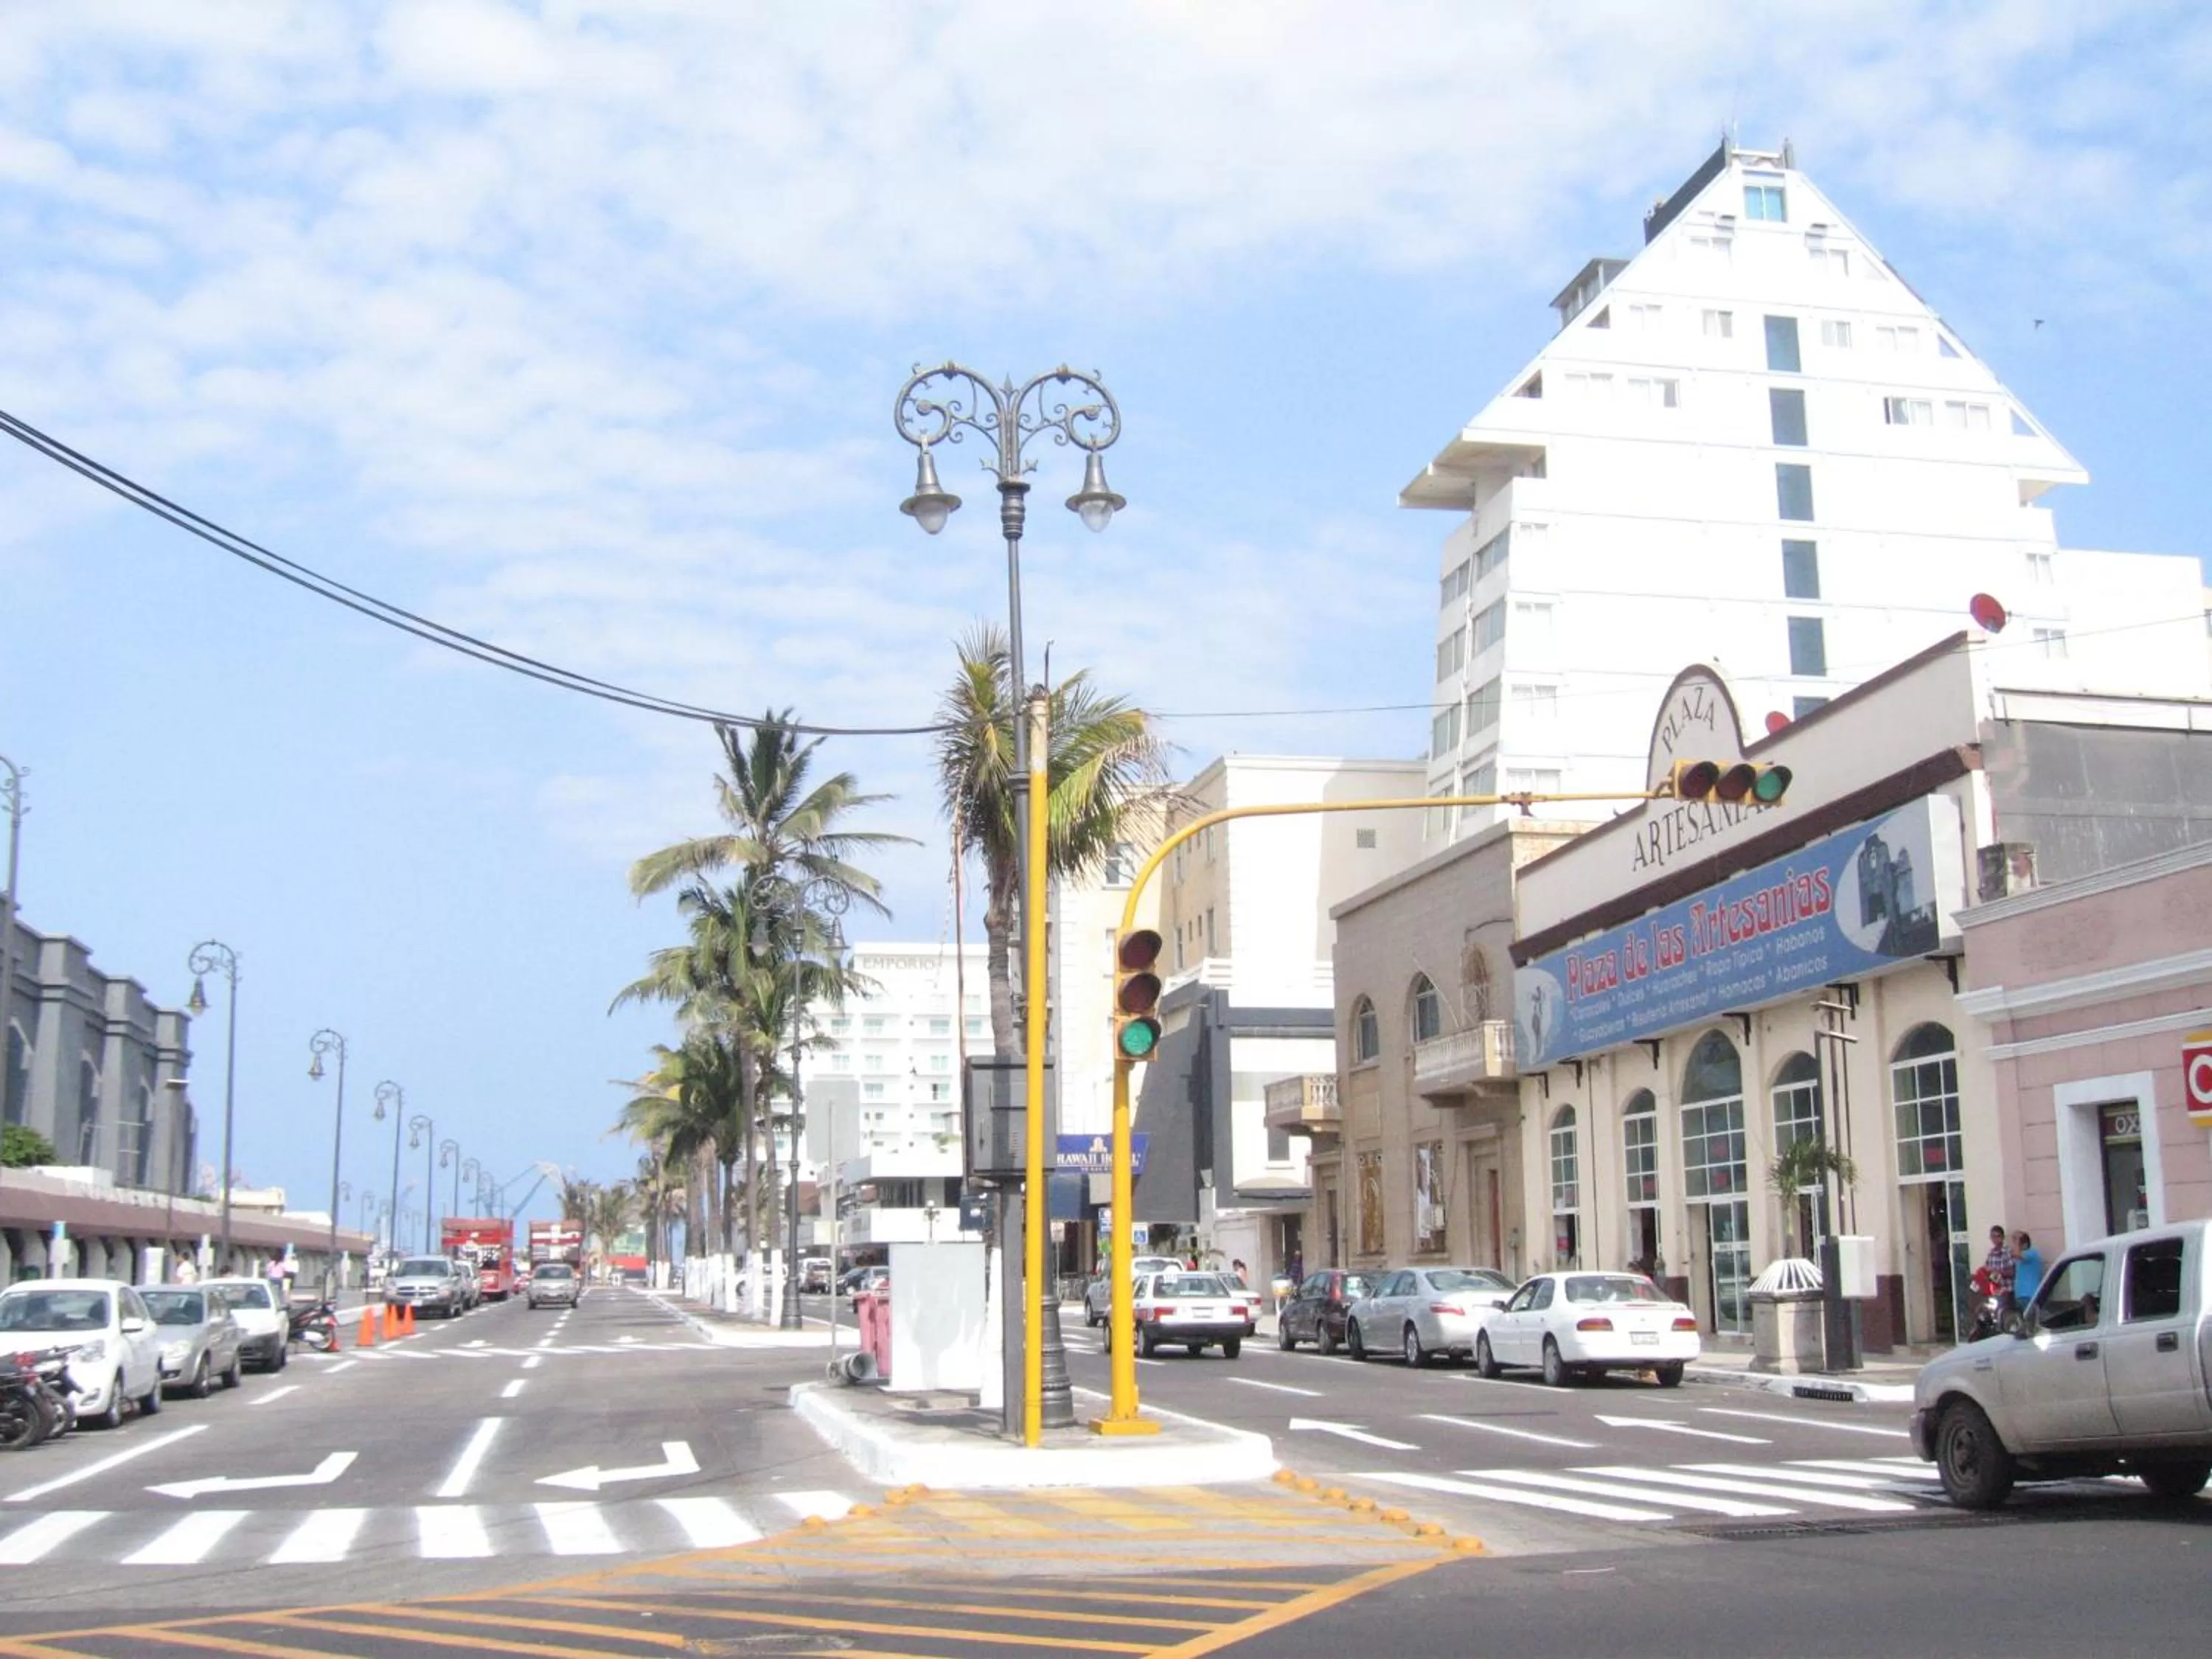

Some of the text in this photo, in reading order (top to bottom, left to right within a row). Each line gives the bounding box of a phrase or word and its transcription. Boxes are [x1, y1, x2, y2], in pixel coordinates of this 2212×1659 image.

[1661, 686, 1715, 755] PLAZA
[1632, 801, 1773, 872] ARTESANI
[1566, 866, 1831, 1004] Plaza de las Artesanias
[863, 956, 936, 970] EMPORIO
[1775, 955, 1828, 983] Abanicos
[1057, 1153, 1139, 1166] HAWAII HOL
